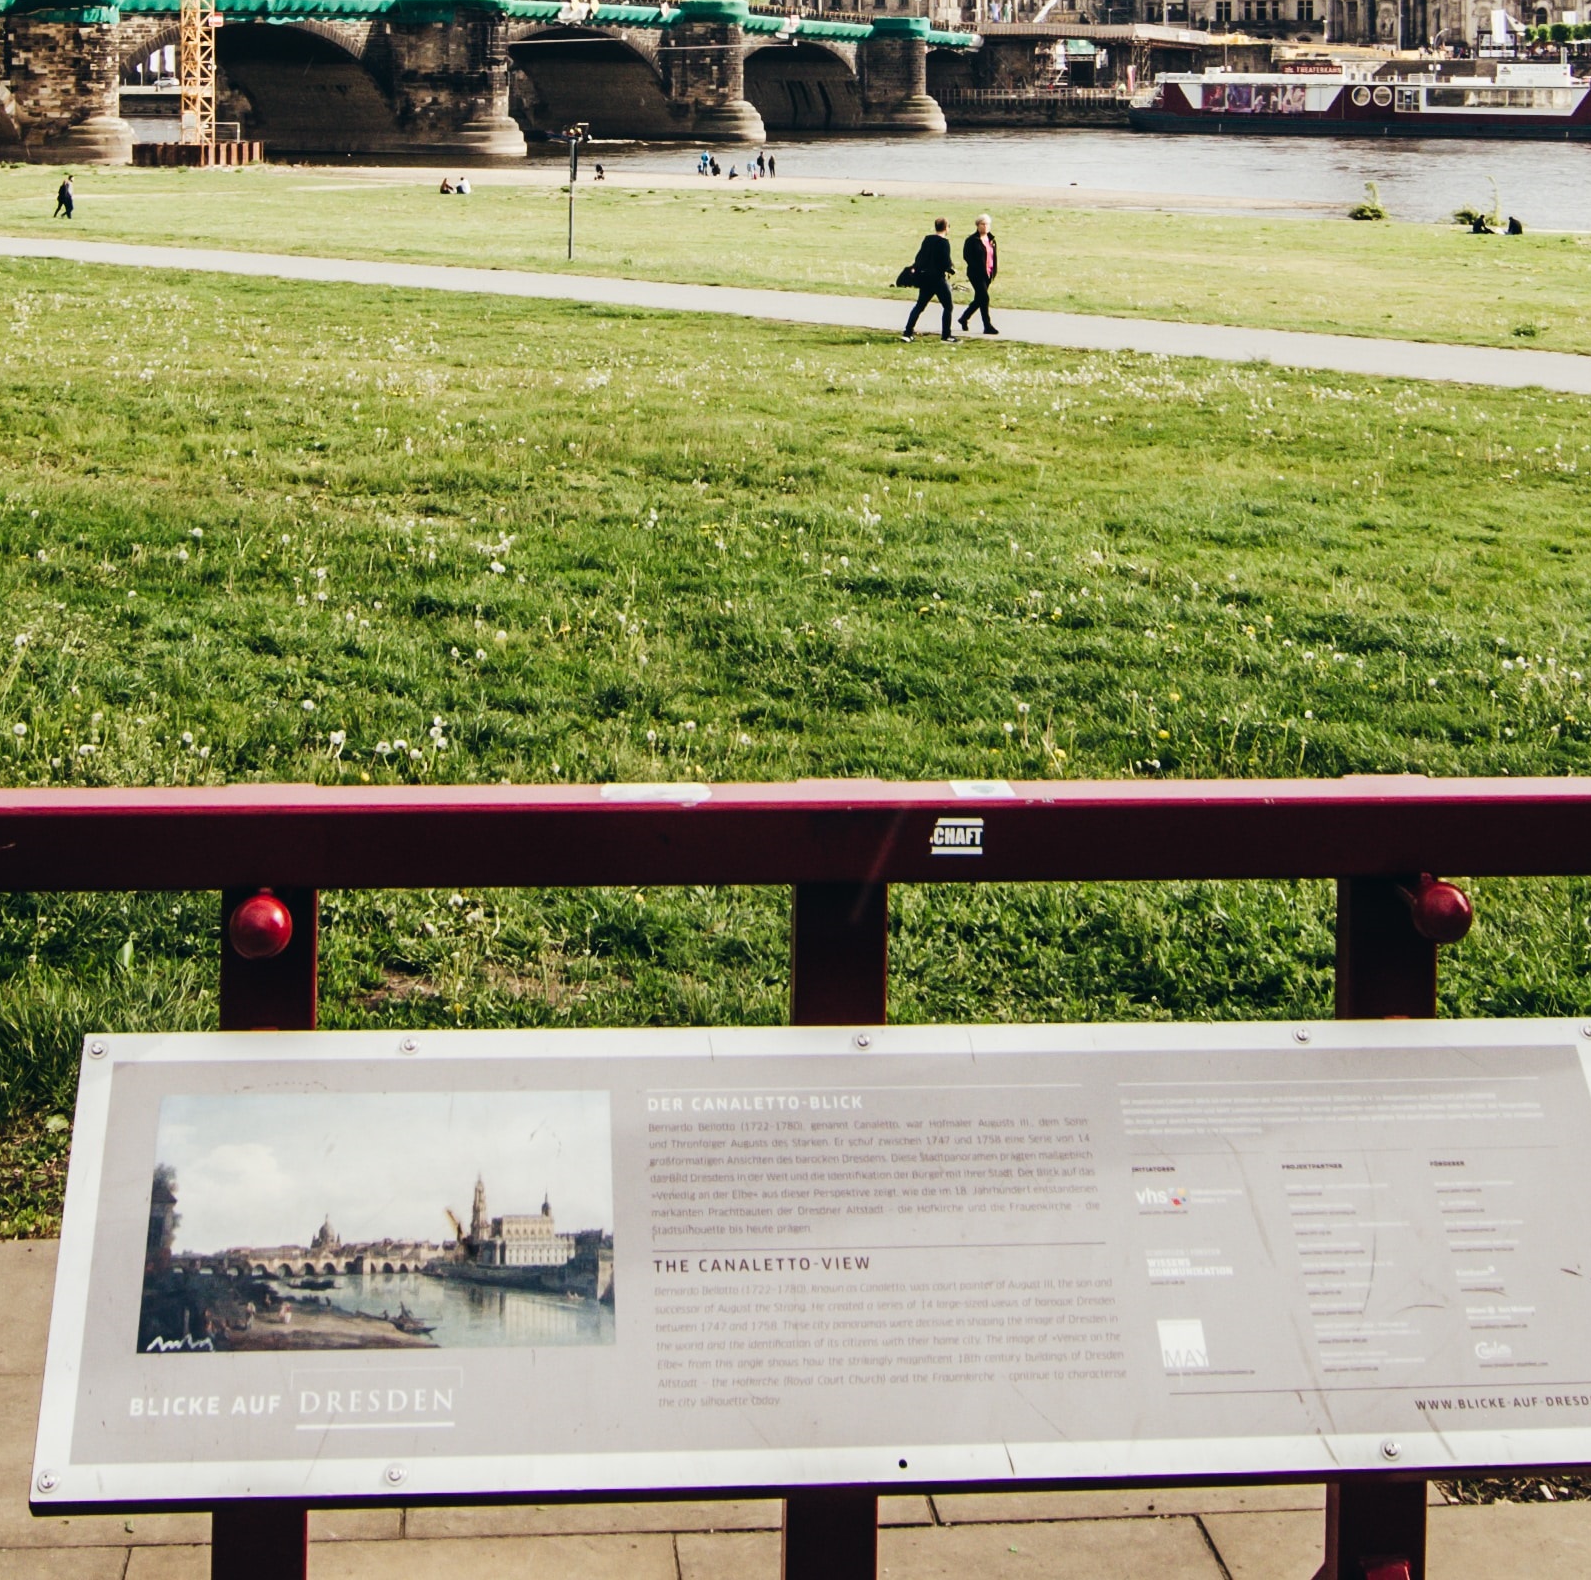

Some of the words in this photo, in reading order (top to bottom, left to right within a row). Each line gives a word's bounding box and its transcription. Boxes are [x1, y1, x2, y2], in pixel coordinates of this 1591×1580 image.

[648, 1097, 684, 1112] DER
[692, 1094, 864, 1111] CANALETTO-BLICK
[648, 1123, 692, 1132] Bernardo
[698, 1122, 735, 1131] Bellotto
[810, 1122, 848, 1130] genannt
[928, 1119, 971, 1127] Hofmaler
[978, 1119, 1014, 1127] Augusts
[1038, 1118, 1059, 1126] dem
[1064, 1117, 1088, 1125] Sohn
[648, 1140, 666, 1148] und
[671, 1139, 725, 1148] Thronfolger
[730, 1139, 767, 1148] Augusts
[771, 1139, 787, 1147] des
[834, 1137, 843, 1145] Er
[848, 1137, 873, 1146] schuf
[878, 1137, 921, 1145] zwischen
[926, 1136, 950, 1144] 1747
[954, 1136, 972, 1144] und
[977, 1135, 1001, 1144] 1758
[1028, 1134, 1052, 1143] Serie
[1078, 1133, 1089, 1142] 14
[649, 1157, 723, 1166] großformatigen
[726, 1155, 773, 1164] Ansichten
[776, 1156, 792, 1164] des
[795, 1155, 839, 1163] barocken
[890, 1153, 916, 1162] Diese
[690, 1173, 734, 1182] Dresdens
[747, 1173, 763, 1181] der
[790, 1172, 808, 1180] und
[810, 1172, 824, 1180] die
[827, 1171, 891, 1180] Identifikation
[1061, 1167, 1076, 1175] auf
[1078, 1167, 1095, 1175] das
[780, 1189, 809, 1197] dieser
[813, 1188, 870, 1197] Perspektive
[921, 1187, 936, 1195] die
[973, 1186, 1030, 1194] Jahrhundert
[1135, 1186, 1168, 1204] vhs
[651, 1208, 703, 1216] markanten
[708, 1207, 772, 1216] Prachtbauten
[777, 1207, 792, 1215] der
[797, 1205, 840, 1215] Dresdner
[846, 1205, 883, 1214] Altstadt
[897, 1205, 912, 1213] die
[916, 1204, 963, 1212] Hofkirche
[968, 1203, 986, 1212] und
[990, 1203, 1004, 1211] die
[1009, 1202, 1071, 1211] Frauenkirche
[1085, 1201, 1100, 1210] die
[652, 1224, 725, 1235] Stadtsilhouette
[729, 1225, 743, 1233] bis
[746, 1225, 773, 1233] heute
[653, 1259, 690, 1273] THE
[699, 1256, 871, 1273] CANALETTO-VIEW
[1148, 1266, 1234, 1277] KOMMUNIKATION
[995, 1280, 1006, 1289] of
[1057, 1279, 1073, 1287] the
[1093, 1278, 1113, 1287] and
[704, 1304, 713, 1312] of
[754, 1303, 770, 1312] the
[811, 1302, 824, 1310] He
[906, 1300, 916, 1309] of
[921, 1300, 933, 1308] 14
[1021, 1297, 1031, 1306] of
[728, 1321, 748, 1330] and
[1006, 1316, 1022, 1324] the
[1055, 1314, 1065, 1323] of
[656, 1342, 672, 1350] the
[706, 1341, 725, 1349] and
[729, 1340, 744, 1349] the
[813, 1338, 824, 1346] of
[827, 1339, 839, 1347] its
[986, 1334, 1003, 1343] The
[1037, 1333, 1047, 1341] of
[1104, 1332, 1121, 1340] the
[802, 1357, 824, 1365] how
[828, 1357, 843, 1365] the
[1070, 1351, 1081, 1359] of
[1165, 1349, 1208, 1368] MAY
[711, 1378, 727, 1387] the
[889, 1374, 909, 1383] and
[912, 1374, 928, 1382] the
[1053, 1371, 1064, 1379] to
[129, 1395, 225, 1417] BLICKE
[231, 1394, 280, 1416] AUF
[299, 1387, 454, 1414] DRESDEN
[658, 1397, 674, 1407] the
